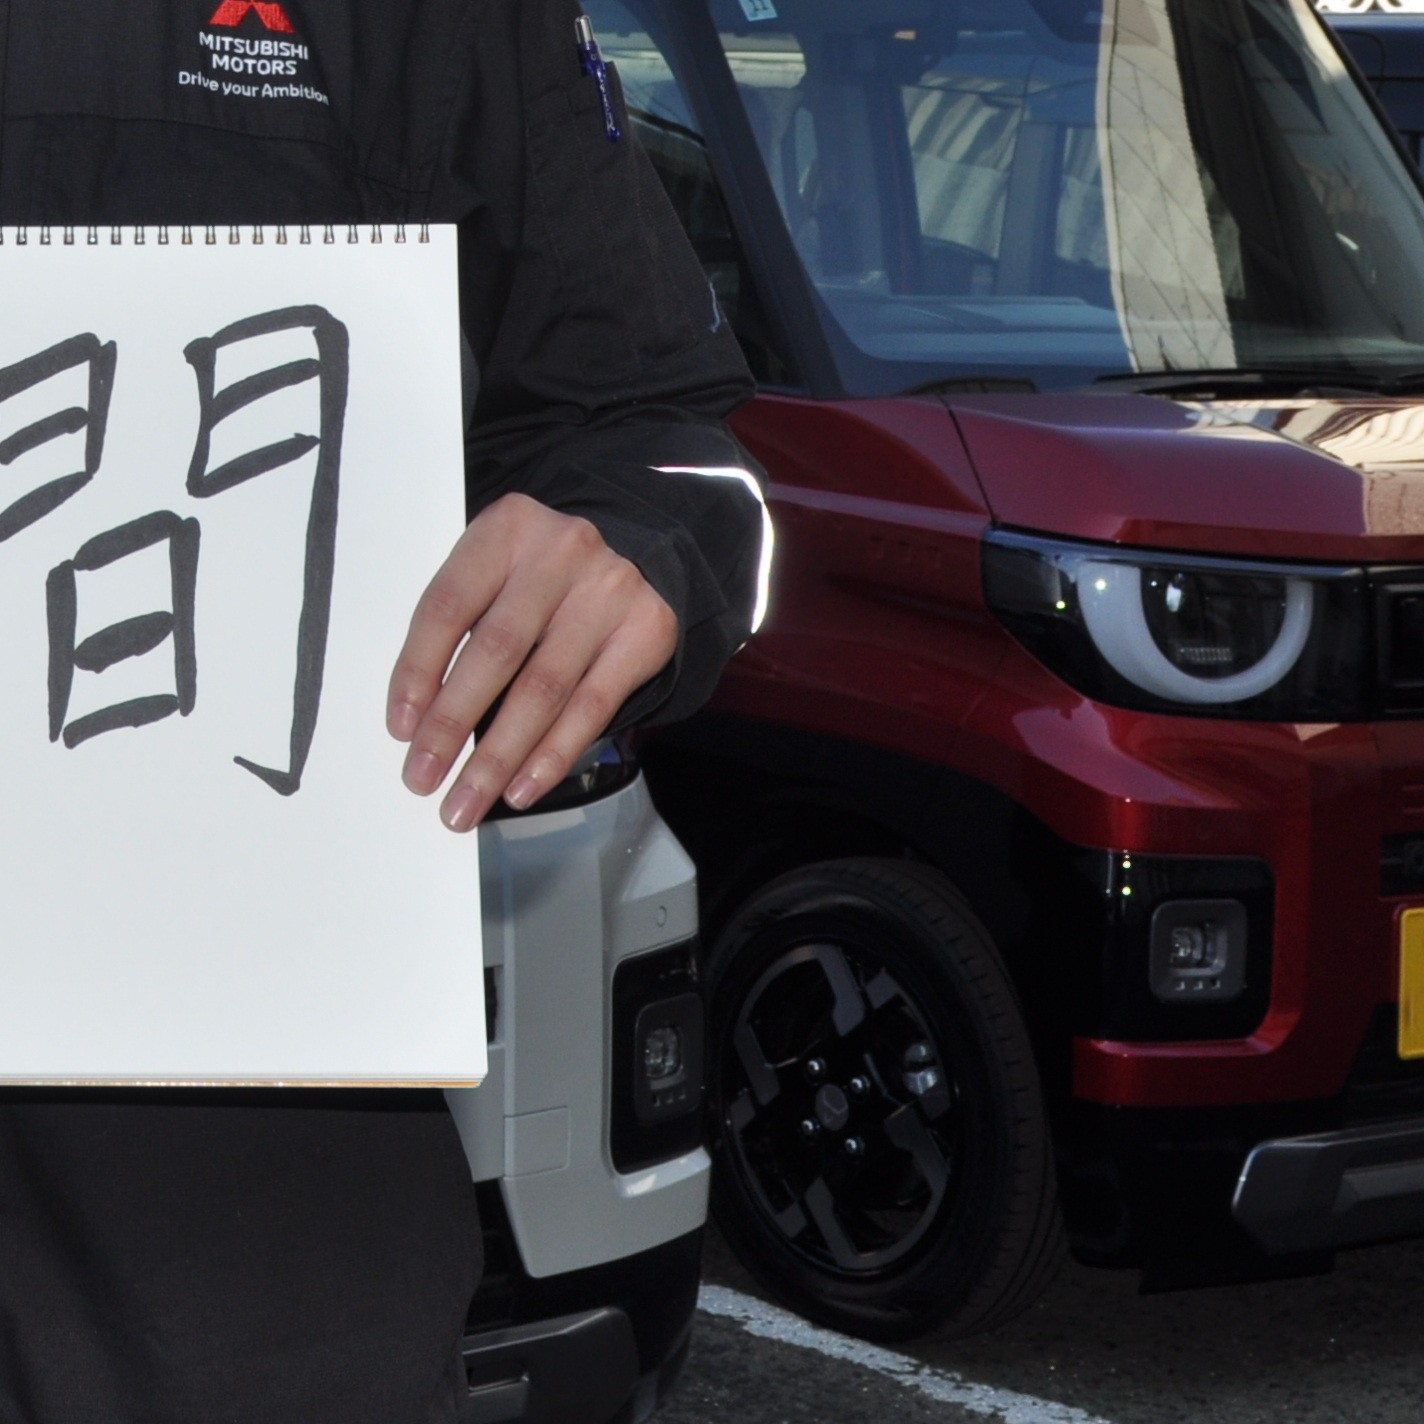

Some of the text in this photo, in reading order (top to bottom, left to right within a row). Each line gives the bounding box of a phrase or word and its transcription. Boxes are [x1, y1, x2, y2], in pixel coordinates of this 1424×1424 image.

[199, 31, 309, 60] MITSUBISHI
[212, 53, 298, 75] MOTORS
[178, 71, 330, 106] Drive your Ambition
